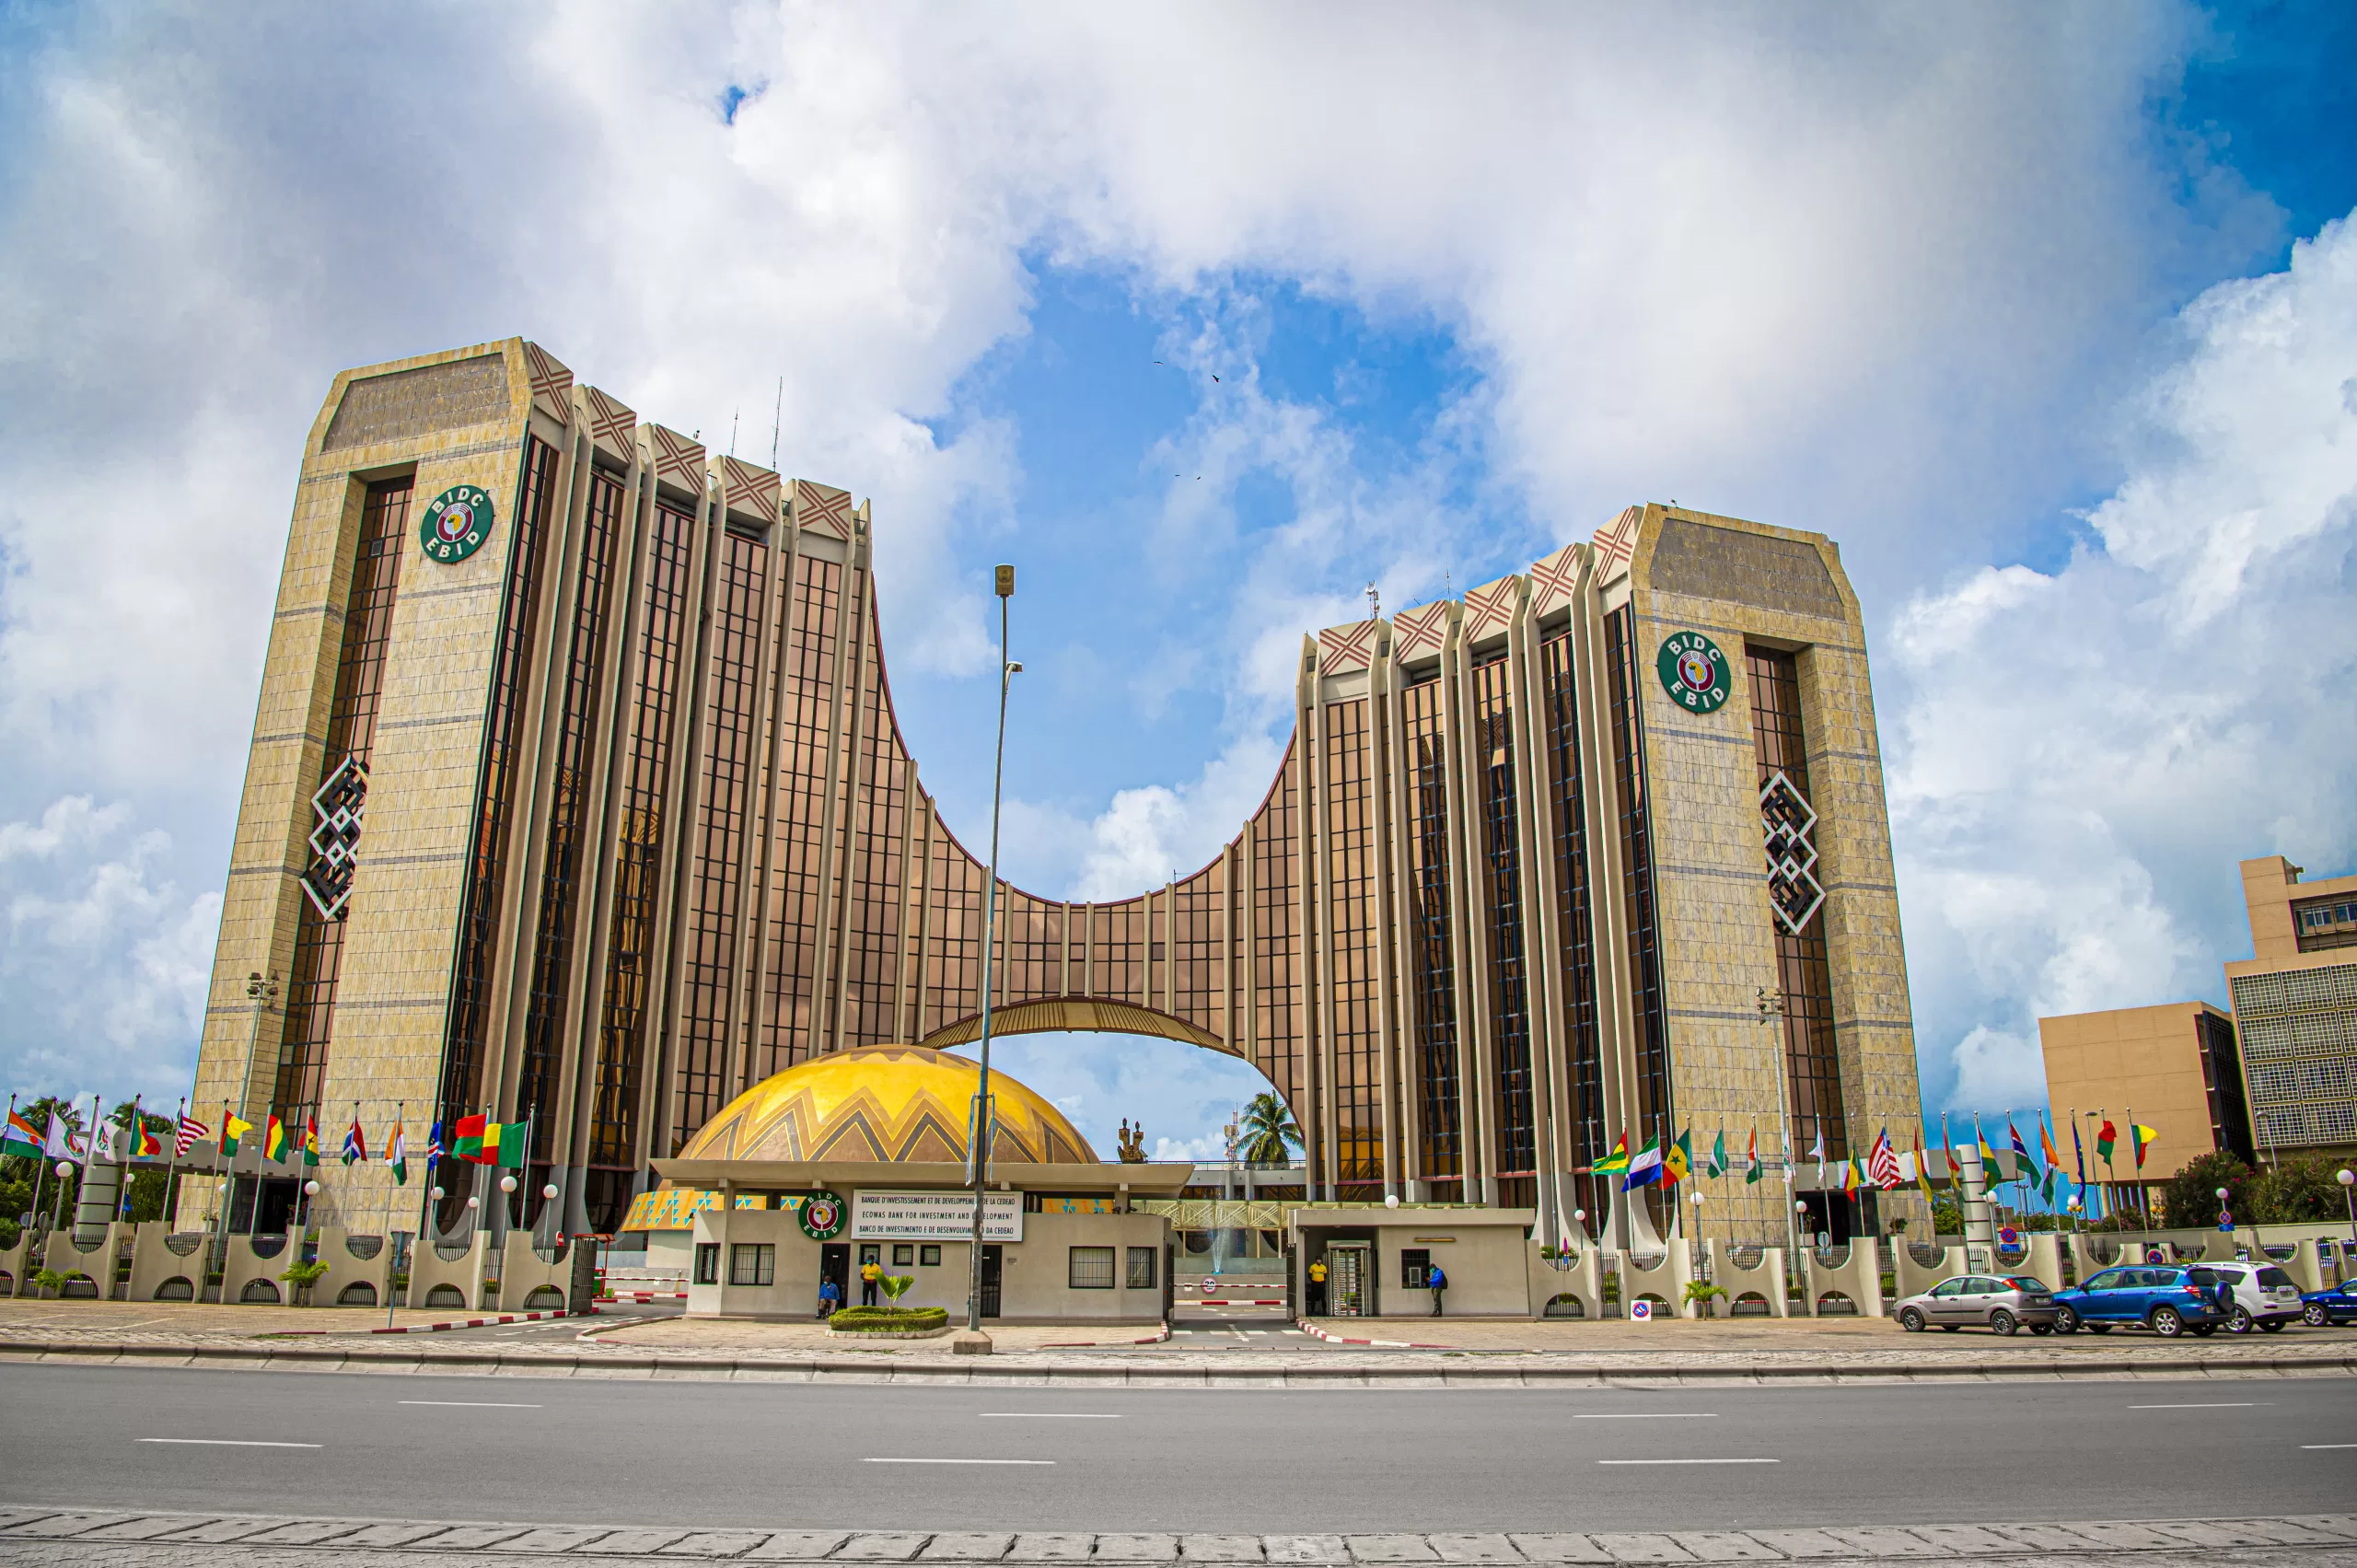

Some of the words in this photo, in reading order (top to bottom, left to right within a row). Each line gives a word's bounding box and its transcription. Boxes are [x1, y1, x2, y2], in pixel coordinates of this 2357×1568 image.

[431, 488, 484, 514] BIDC
[425, 531, 481, 558] EBID
[1667, 635, 1721, 661] BIDC
[1670, 680, 1724, 708] EBID
[807, 1192, 842, 1206] BIDC
[803, 1225, 838, 1237] EBID
